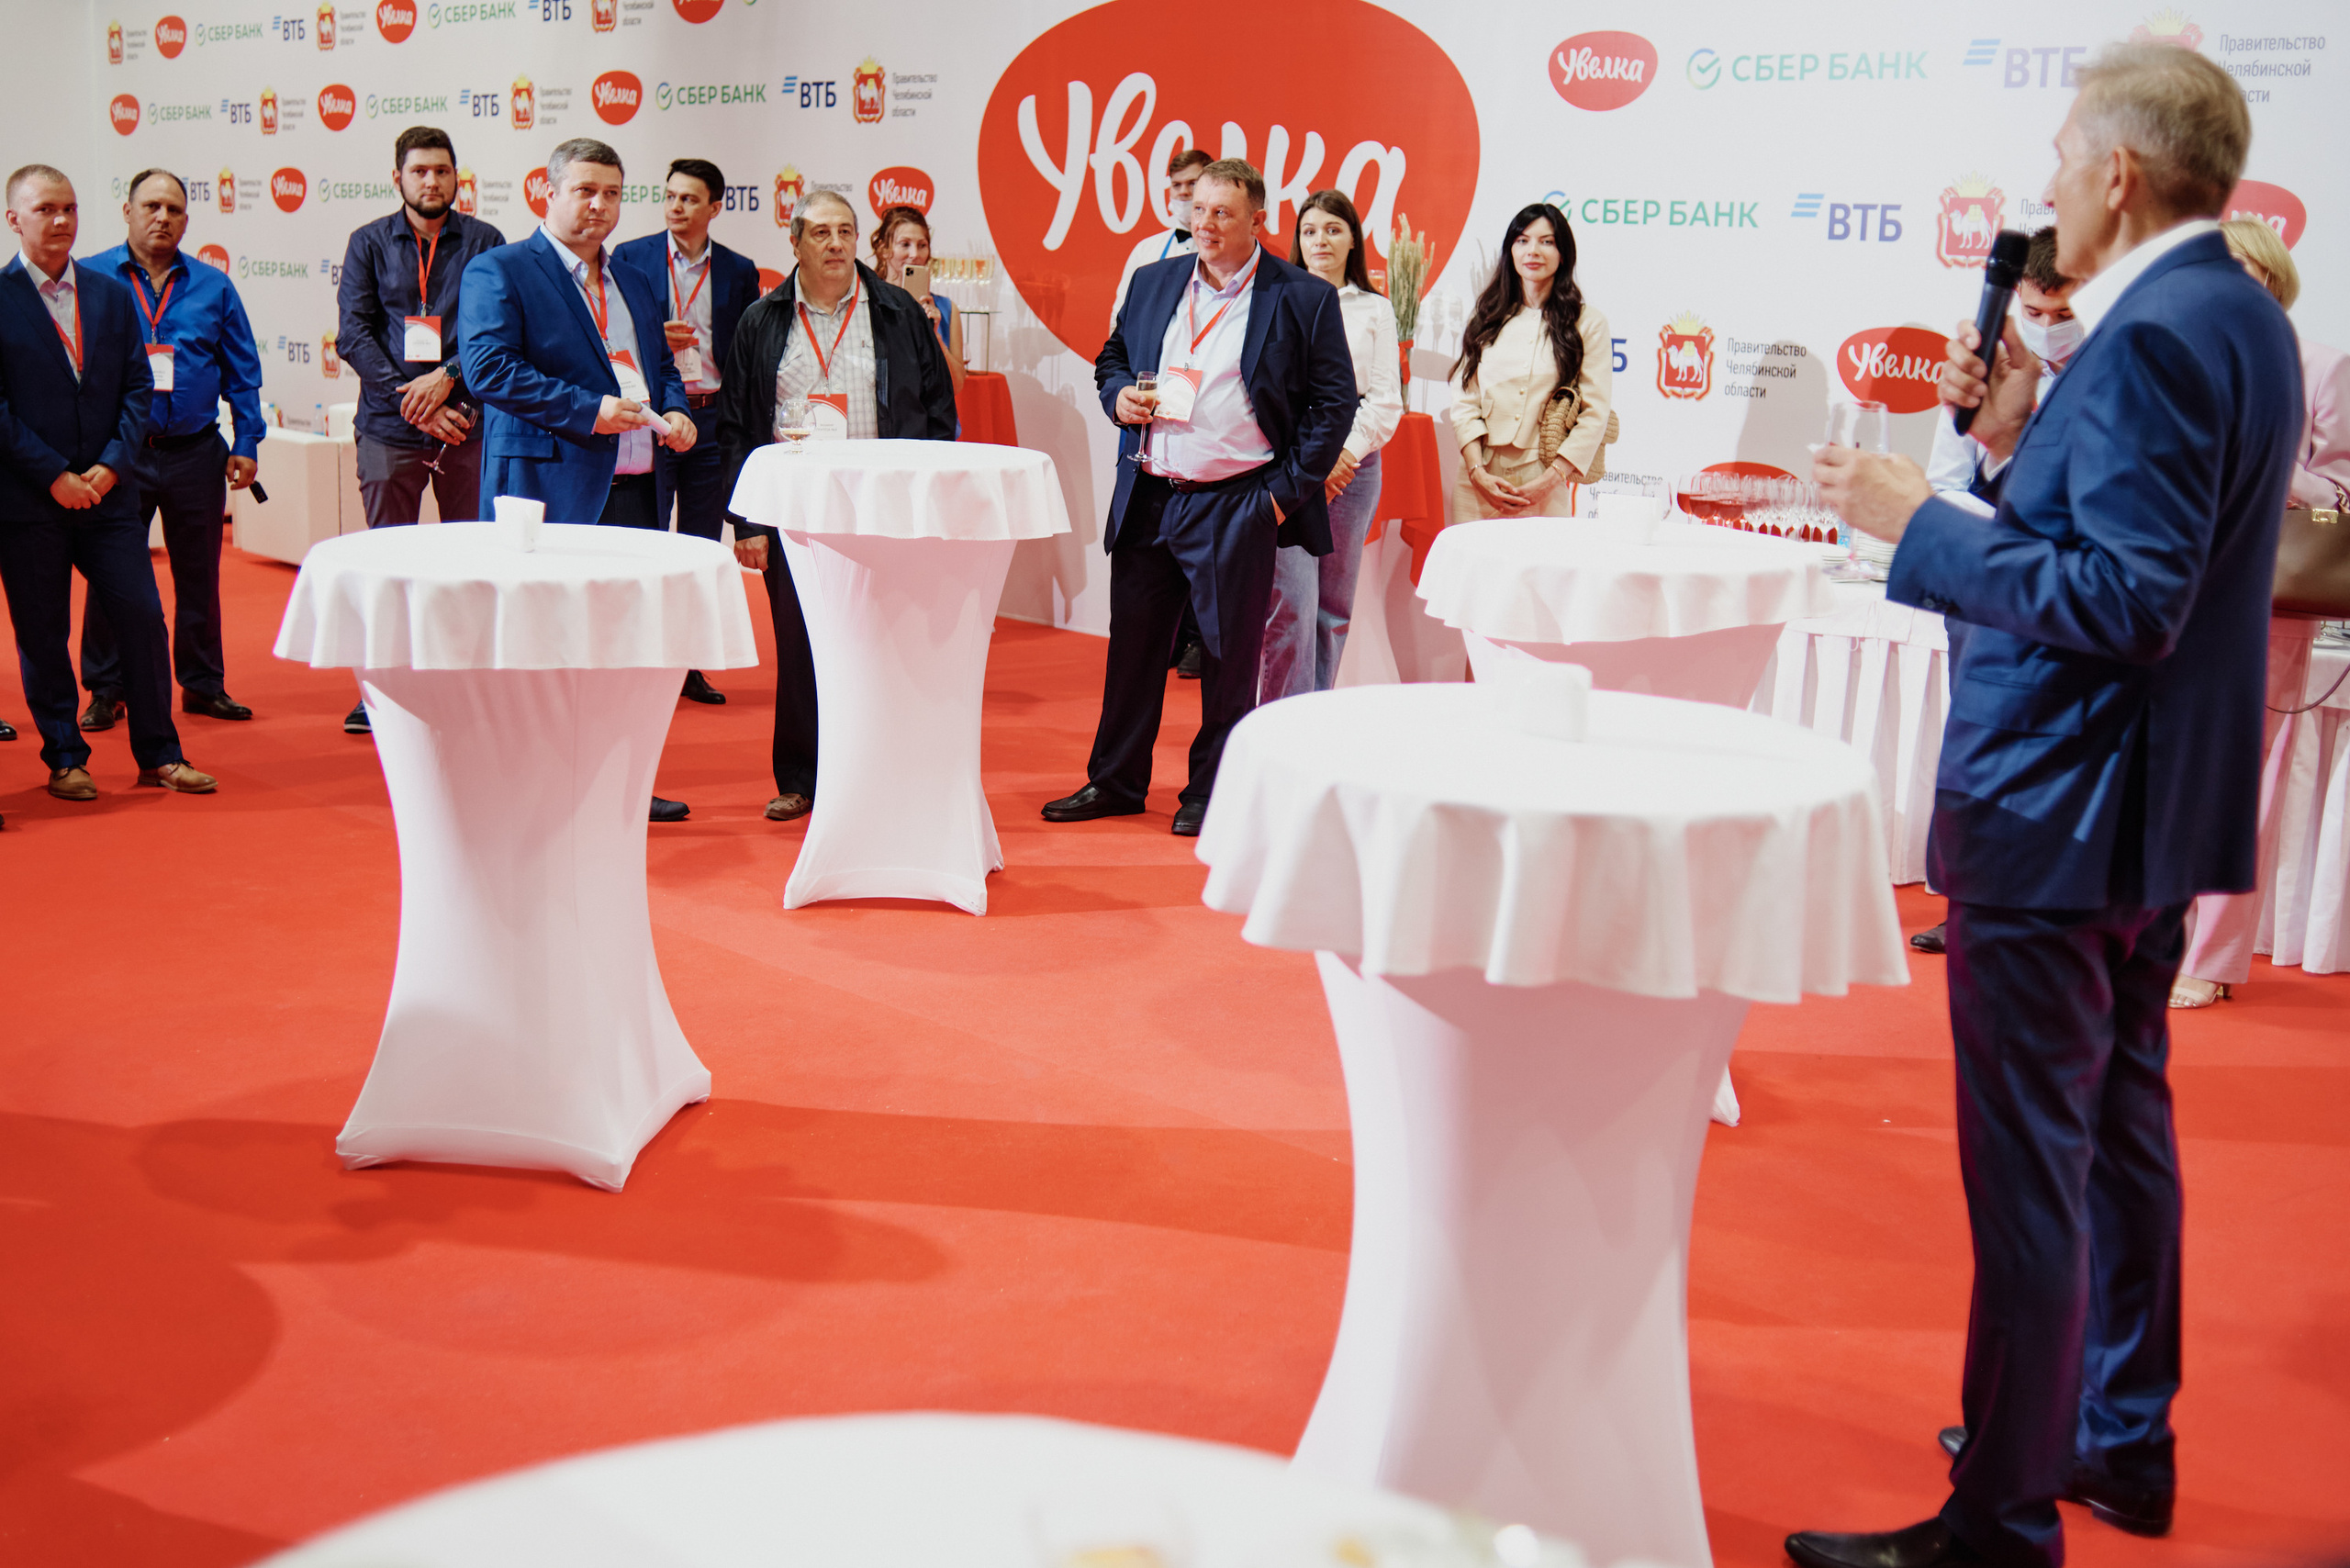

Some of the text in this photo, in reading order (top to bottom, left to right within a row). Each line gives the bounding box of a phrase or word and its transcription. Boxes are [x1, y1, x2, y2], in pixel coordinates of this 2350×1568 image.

[444, 2, 516, 24] СБЕР БАНК
[207, 24, 263, 41] СБЕР БАНК
[283, 18, 305, 40] ВТБ
[2220, 34, 2325, 55] Правительство
[1557, 46, 1645, 85] Увелка
[1732, 50, 1929, 82] СБЕР БАНК
[677, 84, 767, 106] СБЕР БАНК
[800, 81, 837, 108] ВТБ
[160, 105, 212, 121] СБЕР БАНК
[230, 103, 252, 124] ВТБ
[381, 96, 449, 115] СБЕР БАНК
[472, 94, 500, 118] ВТБ
[190, 182, 210, 202] ВТБ
[332, 183, 363, 199] СБЕР
[621, 185, 649, 203] БЕР
[725, 185, 759, 211] ВТБ
[873, 178, 927, 207] Увелка
[1581, 198, 1759, 229] СБЕР БАНК
[1828, 203, 1903, 242] ВТБ
[251, 261, 309, 279] СБЕР БАНК
[287, 341, 311, 364] ВТБ
[1727, 337, 1807, 357] Правительство
[1726, 359, 1796, 379] Челябинской
[1724, 381, 1766, 398] области
